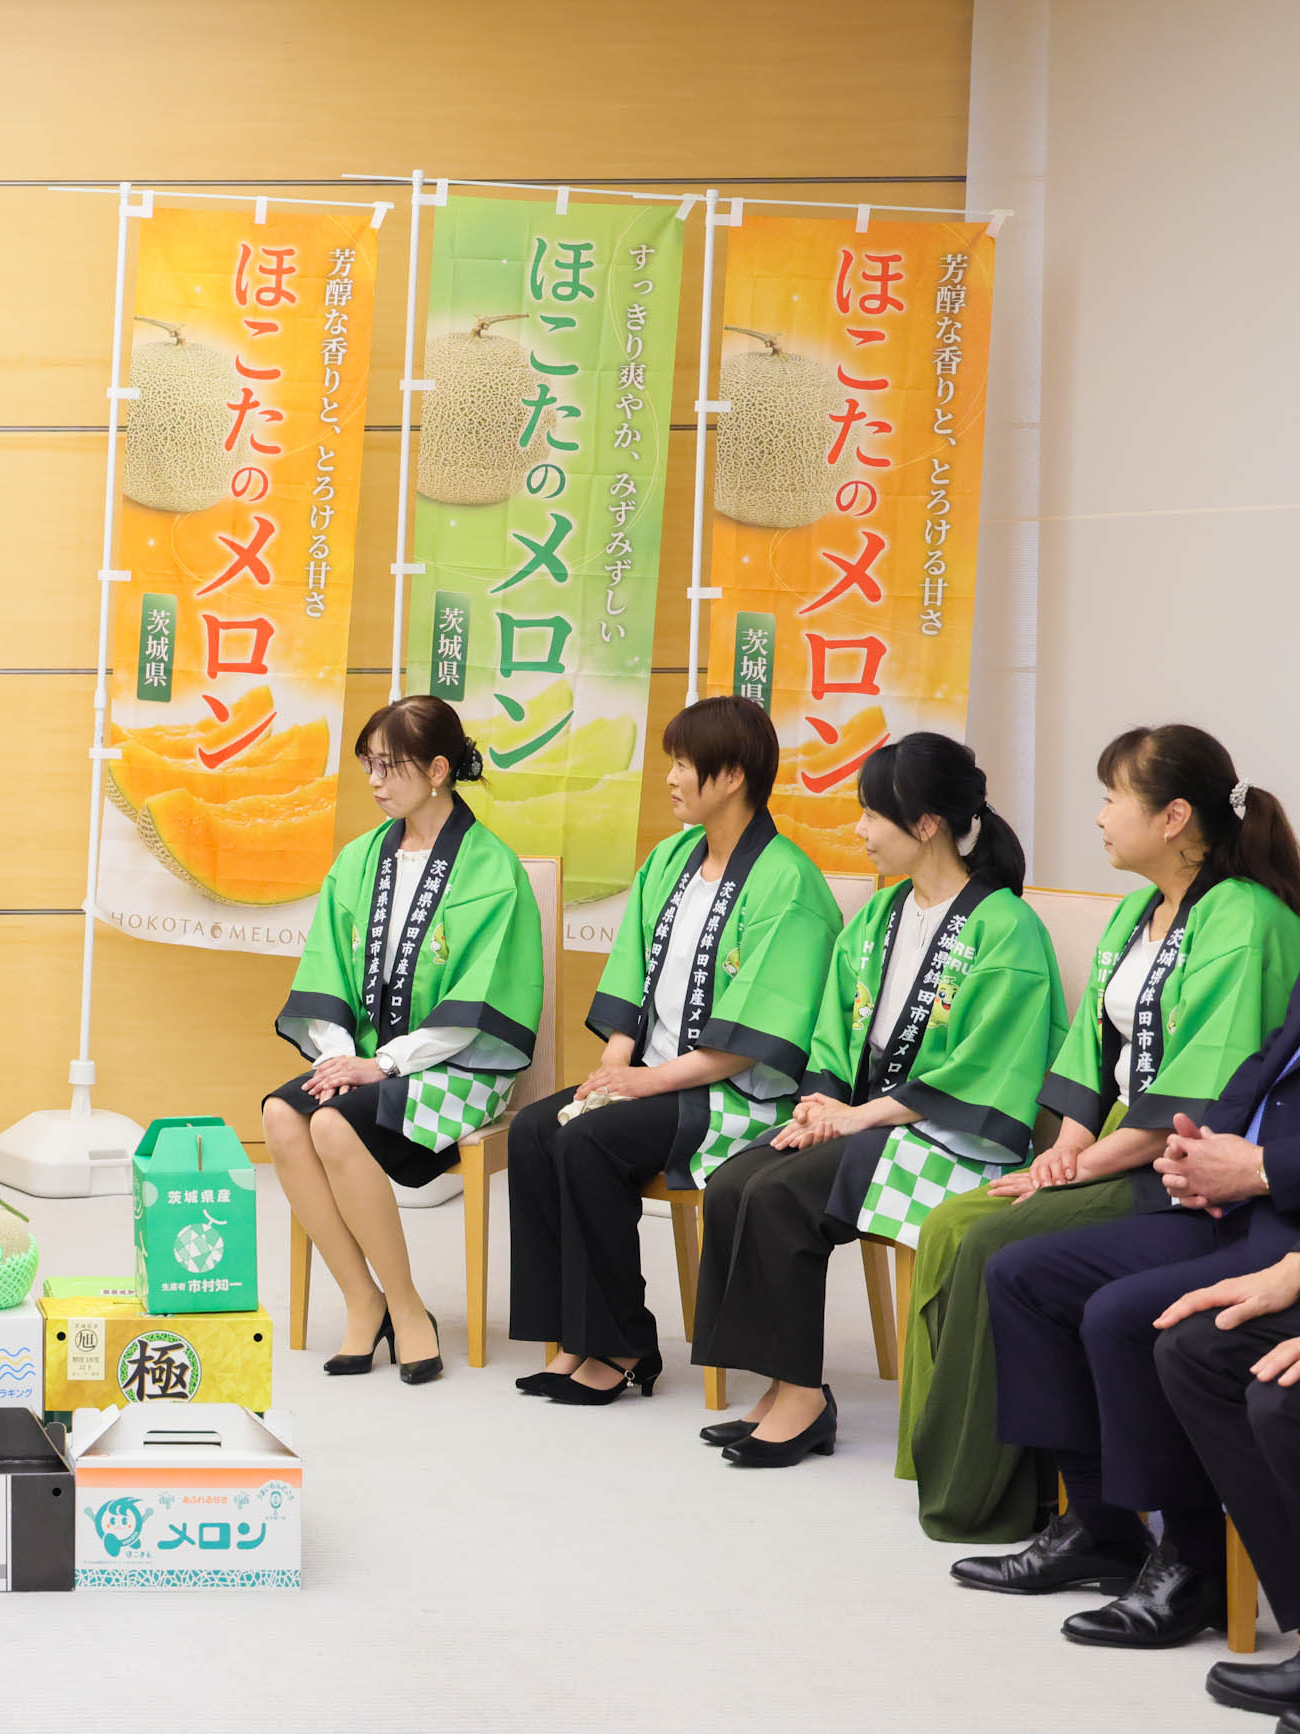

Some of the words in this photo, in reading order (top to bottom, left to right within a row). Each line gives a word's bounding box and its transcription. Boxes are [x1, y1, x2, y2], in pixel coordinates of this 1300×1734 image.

[195, 243, 297, 770] ほこたのメロン
[304, 248, 356, 617] 芳醇な香りと、とろける甘さ
[489, 237, 595, 770] ほこたのメロン
[600, 244, 656, 643] すっきり爽やか、みずみずしい
[919, 253, 969, 636] 芳醇な香りと、とろける甘さ
[799, 249, 904, 793] ほこたのメロン
[144, 609, 171, 687] 茨城県
[437, 607, 464, 687] 茨城県
[110, 912, 205, 936] HOKOTA
[389, 859, 450, 1026] 茨城県鉾田市産メロン
[687, 881, 737, 1051] 茨城県鉾田市産メロ
[881, 914, 968, 1093] 茨城県鉾田市産メロン
[167, 1189, 231, 1204] 茨城県産
[187, 1278, 243, 1293] 市村知一
[122, 1338, 190, 1402] 極
[157, 1522, 267, 1550] メロン
